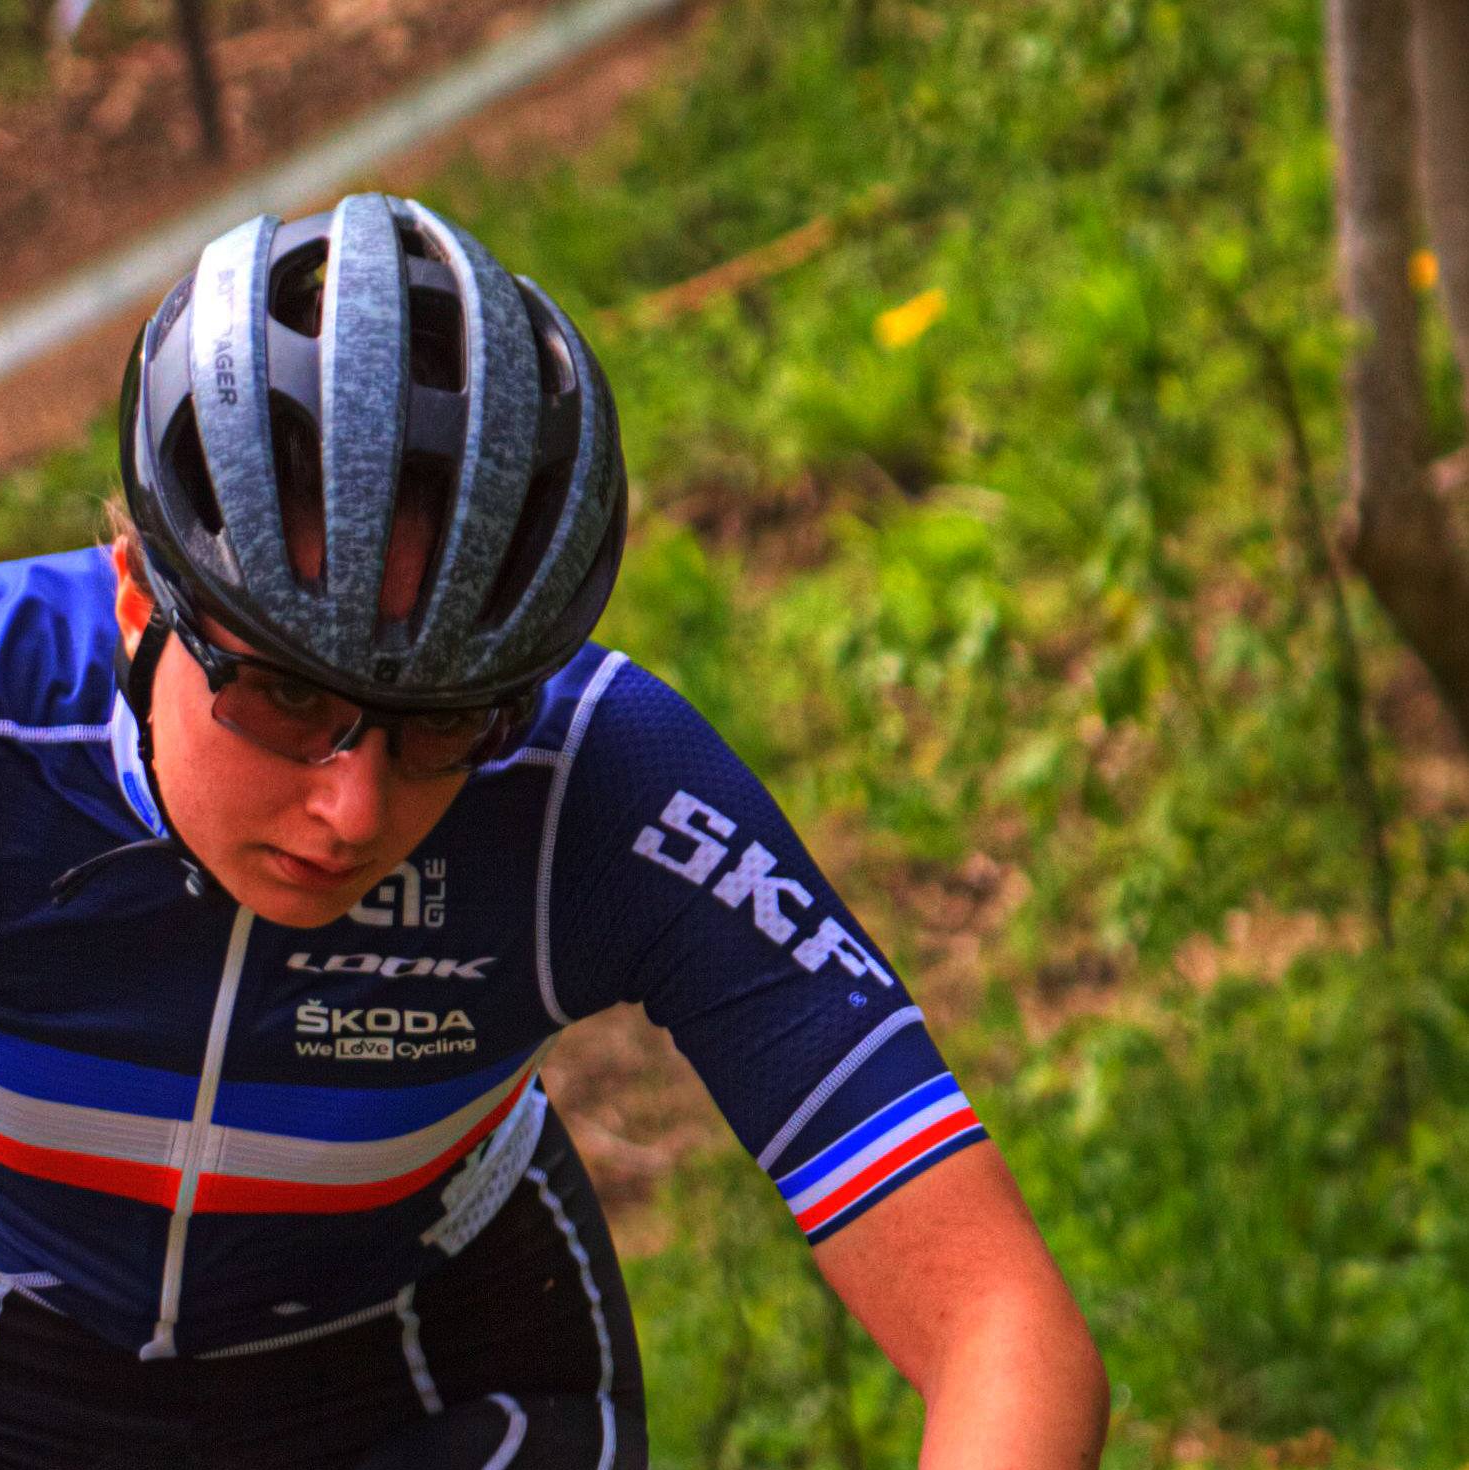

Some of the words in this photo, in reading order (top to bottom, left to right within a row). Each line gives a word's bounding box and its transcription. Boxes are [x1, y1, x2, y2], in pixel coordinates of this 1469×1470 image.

[632, 789, 894, 988] SKF
[286, 952, 498, 979] LOOK
[295, 999, 475, 1034] ŠKODA
[295, 1040, 333, 1056] We
[396, 1037, 476, 1059] Cycling
